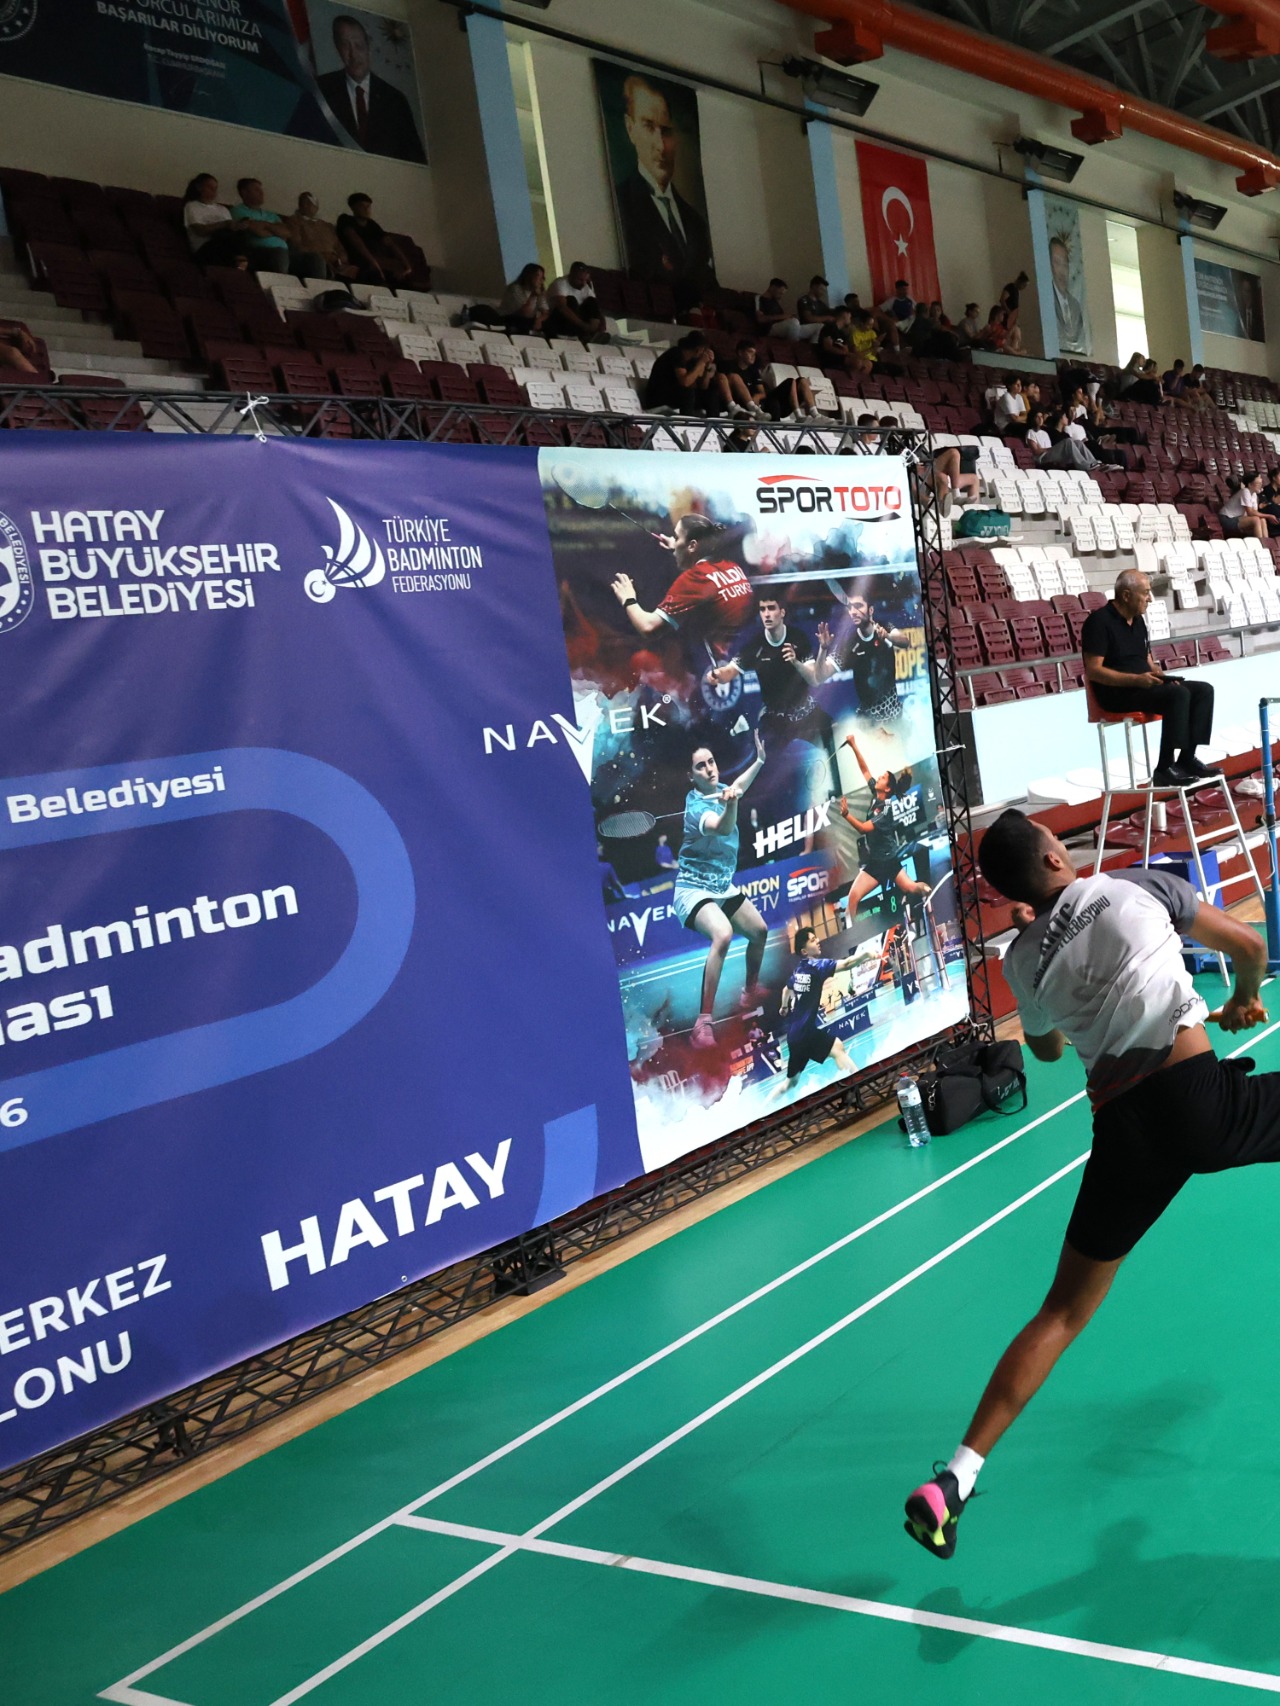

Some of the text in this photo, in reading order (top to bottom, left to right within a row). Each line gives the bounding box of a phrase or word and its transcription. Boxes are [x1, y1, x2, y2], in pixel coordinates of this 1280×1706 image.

[96, 1, 260, 54] BAŞARILAR DİLİYORUM
[31, 509, 165, 543] HATAY
[382, 515, 452, 543] TÜRKİYE
[38, 542, 282, 582] BÜYÜKŞEHİR
[386, 541, 484, 572] BADMİNTON
[46, 578, 256, 620] BELEDİYESİ
[392, 573, 472, 593] FEDERASYONU
[483, 691, 667, 787] NAVEK
[7, 766, 226, 824] Belediyesi
[752, 800, 832, 859] HELIX
[0, 985, 114, 1046] ası
[0, 1097, 29, 1128] 6
[260, 1138, 513, 1292] HATAY
